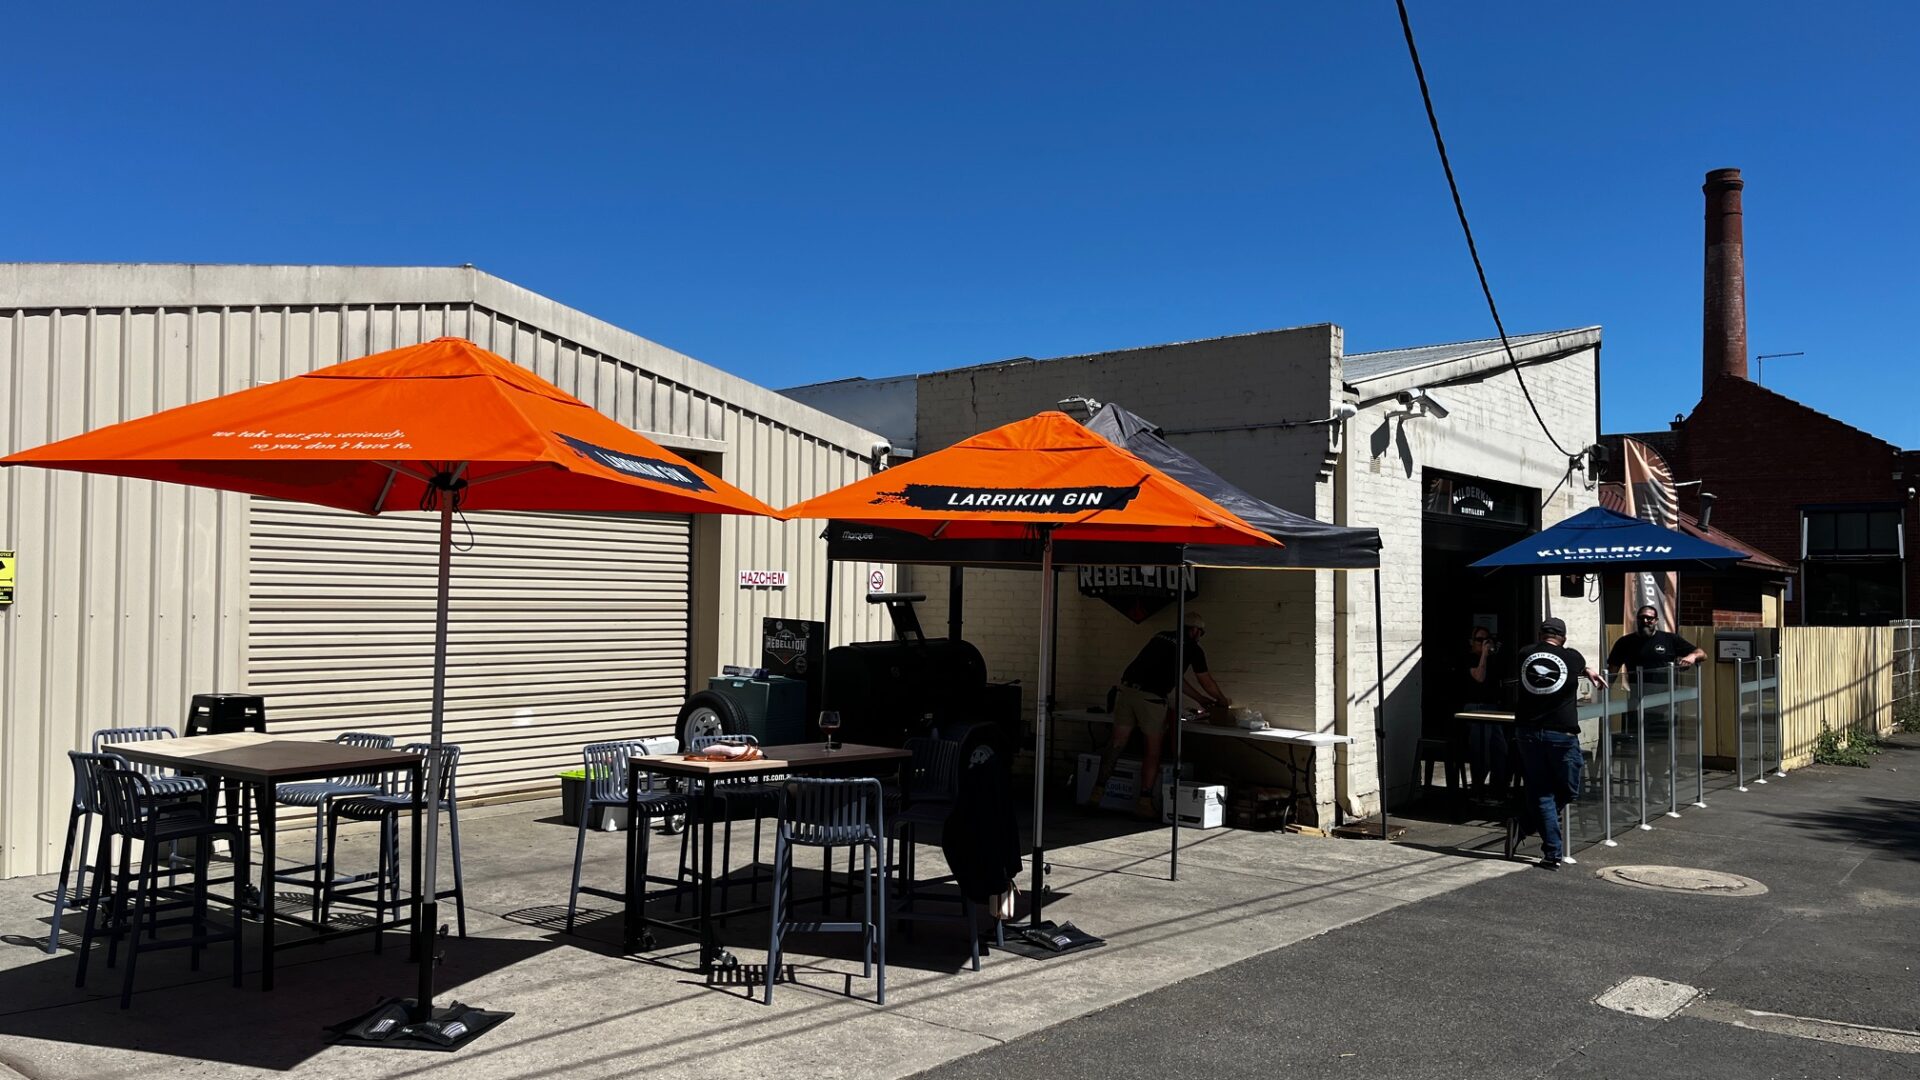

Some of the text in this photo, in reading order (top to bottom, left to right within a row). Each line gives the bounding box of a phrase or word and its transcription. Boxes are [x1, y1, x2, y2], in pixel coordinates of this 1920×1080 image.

[237, 430, 272, 438] take
[266, 443, 302, 451] you
[947, 492, 1103, 506] LARRIKIN GIN
[1537, 546, 1672, 557] KILDERKIN
[740, 571, 785, 585] HAZCHEM
[766, 637, 805, 651] REBELLION
